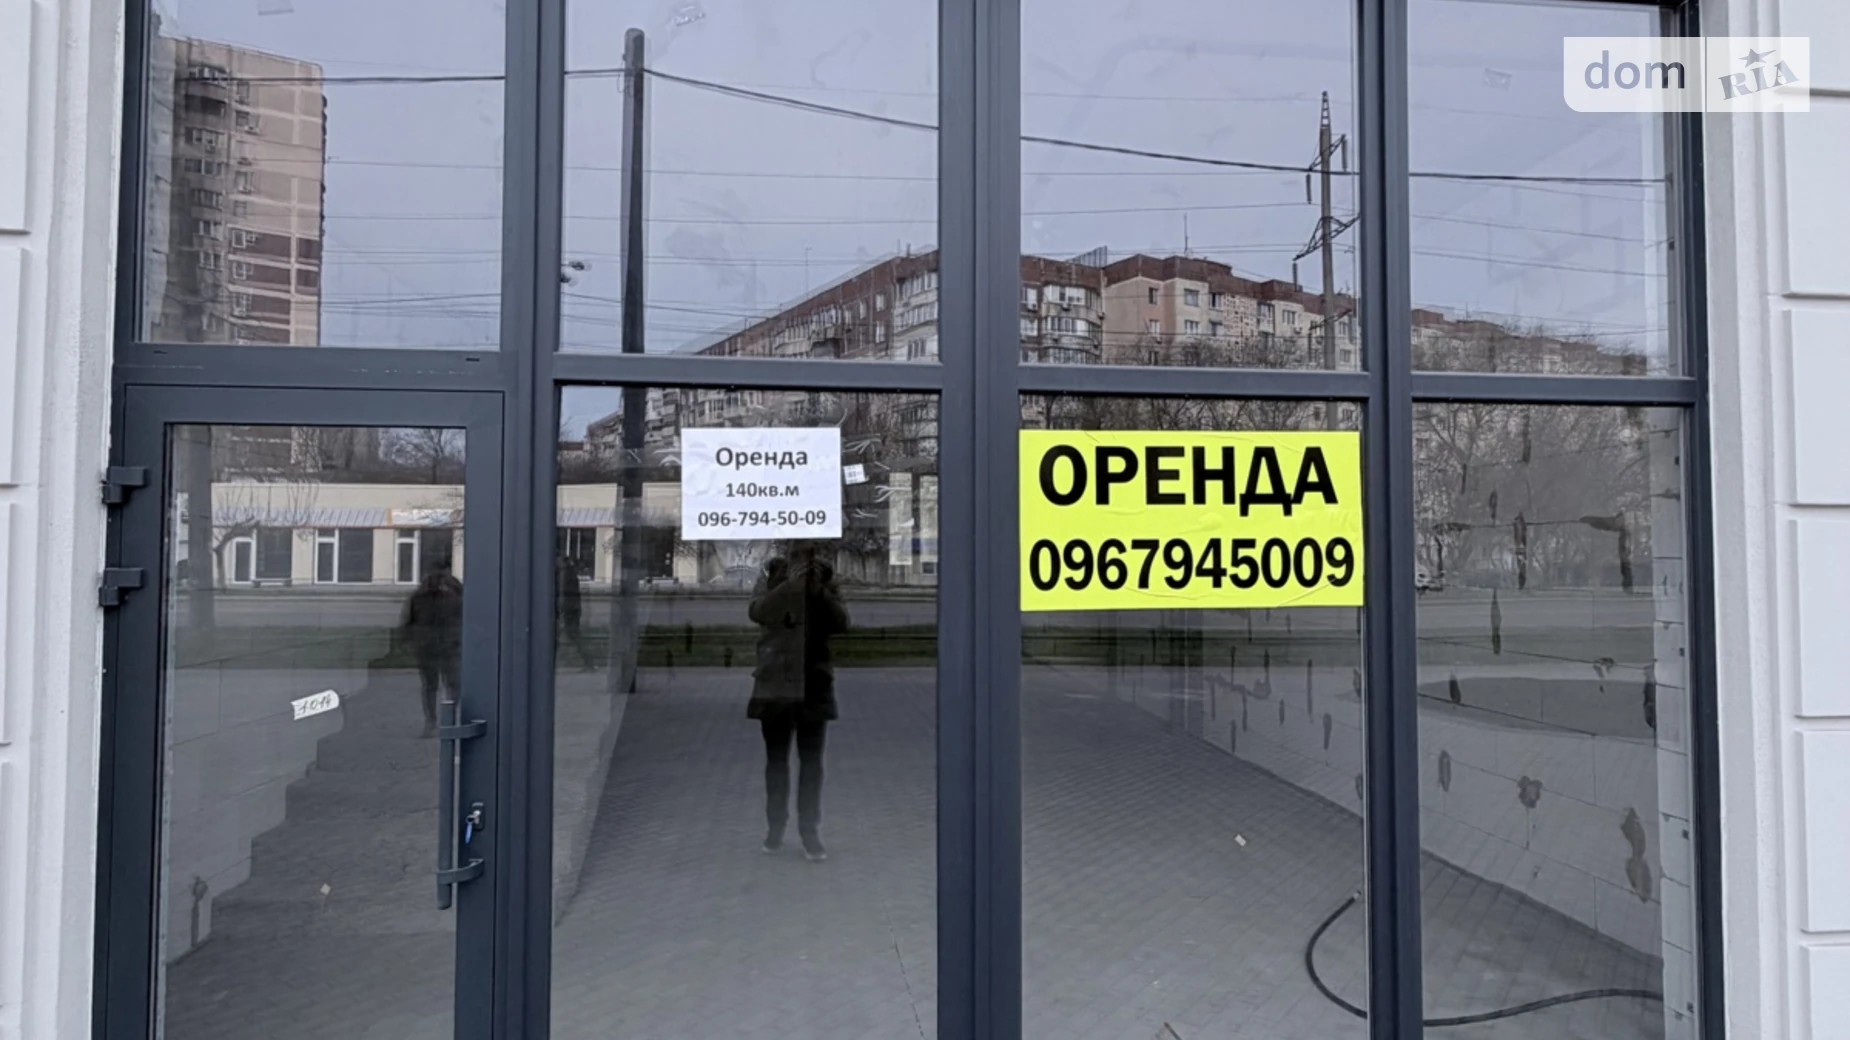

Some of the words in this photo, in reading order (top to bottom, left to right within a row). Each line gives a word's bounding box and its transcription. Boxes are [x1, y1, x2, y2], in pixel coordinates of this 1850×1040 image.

[715, 447, 808, 471] Оренда
[725, 482, 800, 498] 140кв.м
[1038, 444, 1339, 517] ОРЕНДА
[697, 510, 827, 527] 096-794-50-09
[1029, 536, 1355, 591] 0967945009
